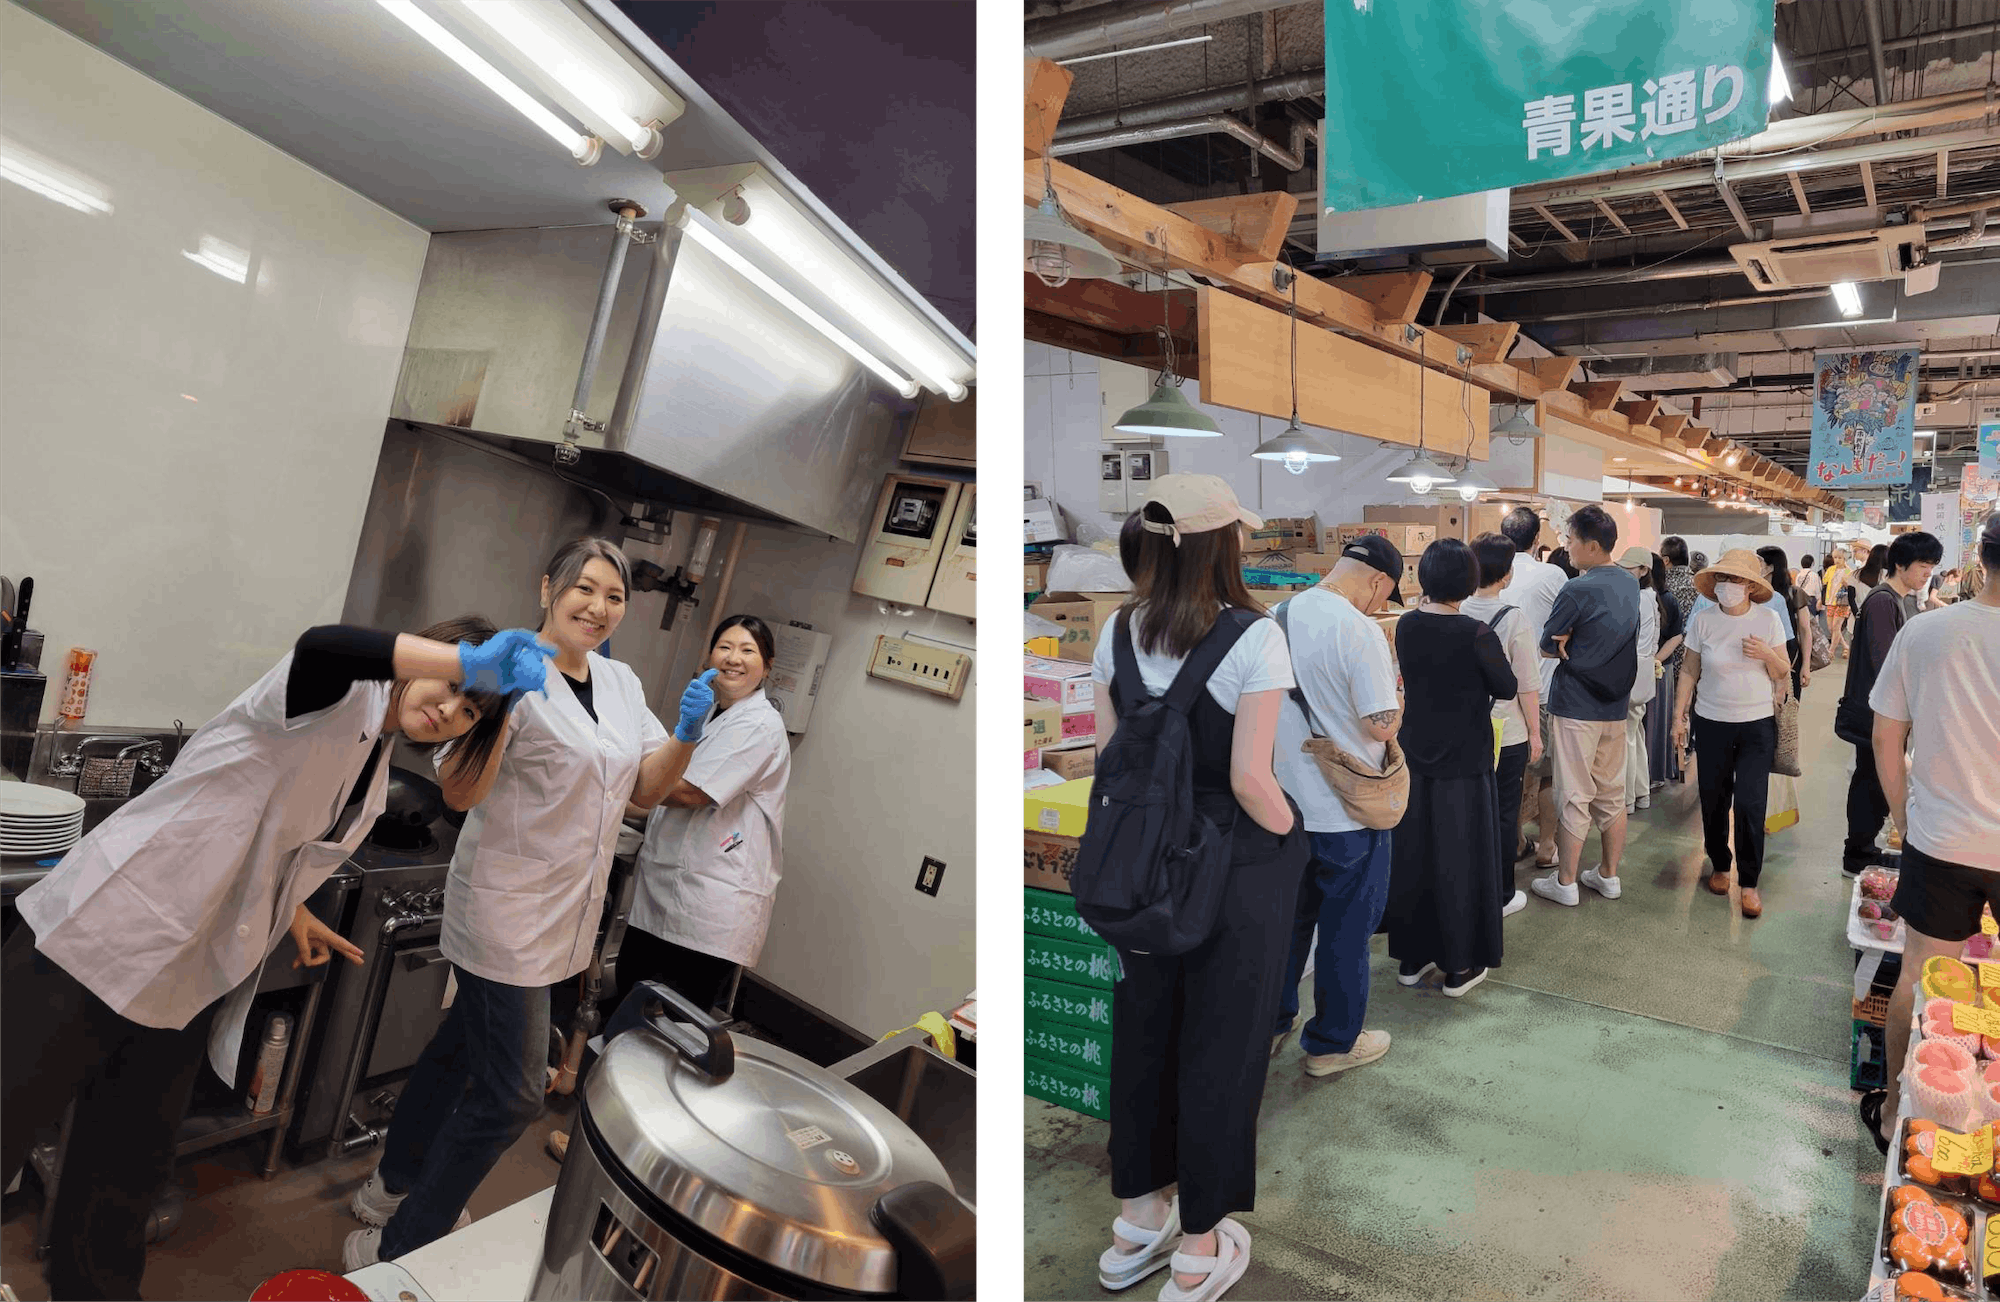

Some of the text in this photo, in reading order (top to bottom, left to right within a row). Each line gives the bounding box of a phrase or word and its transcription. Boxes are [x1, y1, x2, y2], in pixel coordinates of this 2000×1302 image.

[1522, 64, 1744, 161] 青果通り
[1027, 949, 1109, 981] ふるさとの桃
[1028, 991, 1109, 1025] ふるさとの桃
[1025, 1029, 1101, 1066] ふるさとの桃
[1027, 1071, 1101, 1110] ふるさとの桃
